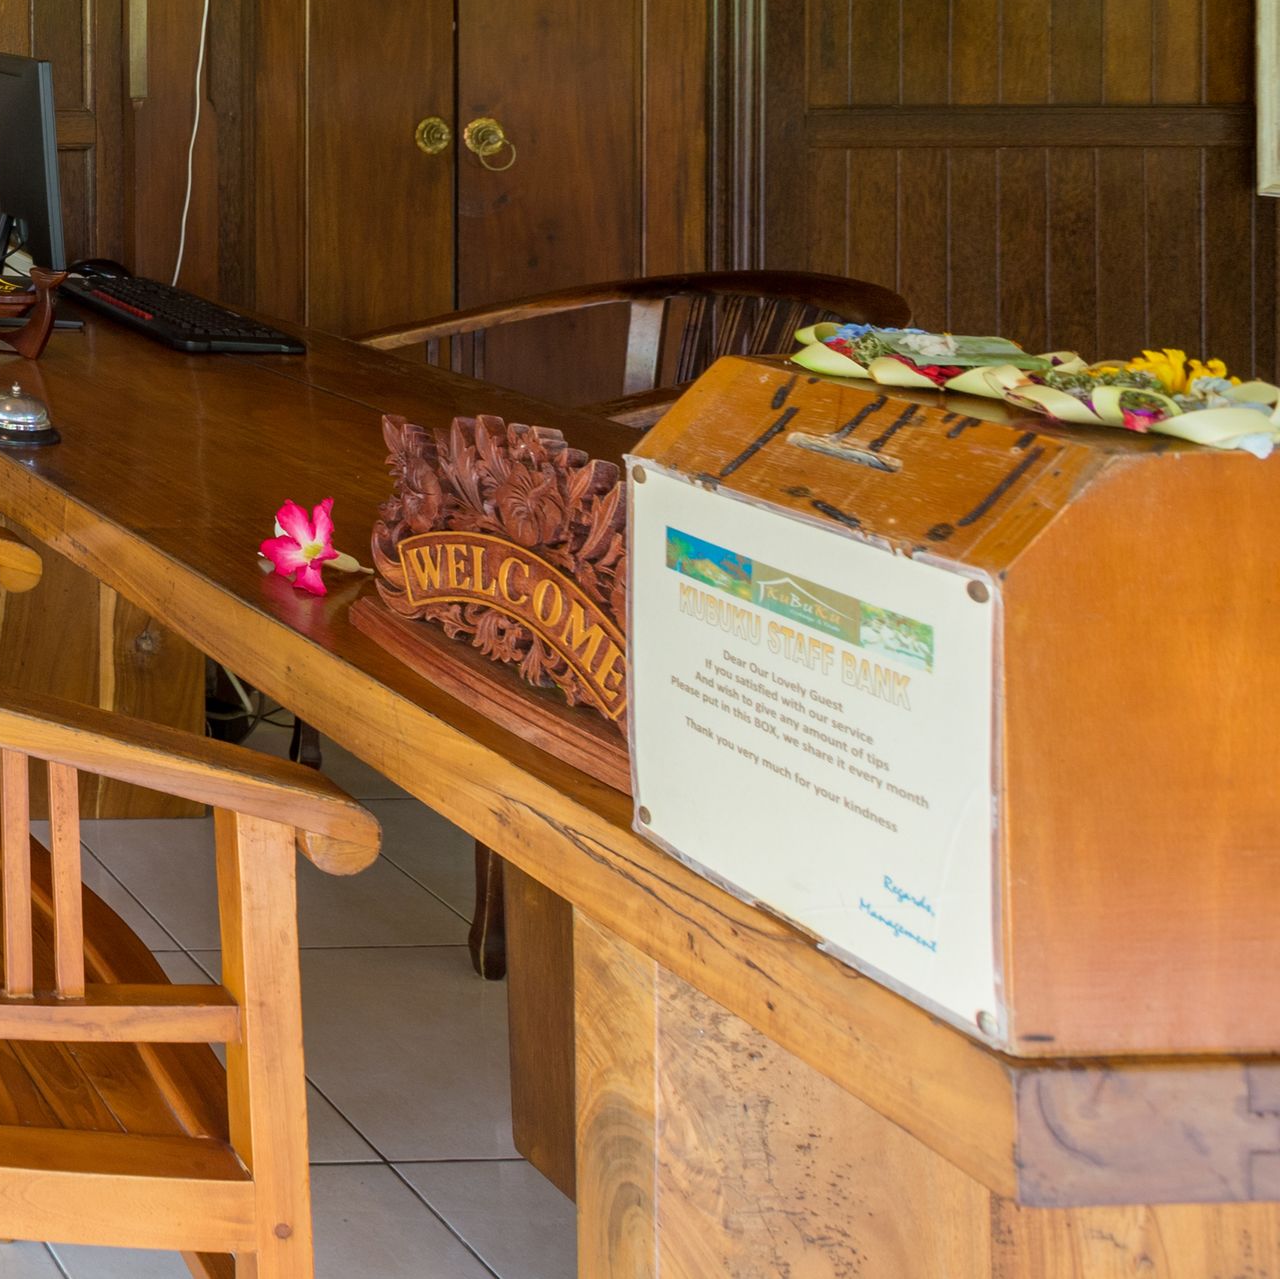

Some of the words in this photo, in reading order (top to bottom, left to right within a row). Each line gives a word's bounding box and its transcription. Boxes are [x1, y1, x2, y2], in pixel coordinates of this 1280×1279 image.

[406, 543, 627, 703] WELCOME
[678, 581, 762, 646] KUBUKU
[766, 619, 836, 677] STAFF
[840, 649, 912, 712] BANK
[694, 671, 715, 689] And
[716, 680, 740, 700] wish
[741, 694, 753, 706] to
[754, 699, 777, 720] give
[779, 713, 799, 732] any
[802, 722, 849, 753] amount
[851, 744, 865, 760] of
[866, 751, 890, 772] tips
[704, 658, 713, 670] If
[713, 665, 733, 681] you
[735, 672, 779, 702] satisfied
[781, 694, 807, 715] with
[808, 708, 829, 725] our
[831, 719, 875, 746] service
[722, 649, 747, 669] Dear
[749, 662, 769, 678] Our
[771, 671, 807, 698] Lovely
[809, 689, 844, 714] Guest
[670, 674, 701, 700] Please
[702, 691, 719, 711] put
[720, 699, 731, 713] in
[732, 705, 751, 725] this
[753, 716, 780, 741] BOX,
[782, 731, 800, 748] we
[802, 738, 834, 765] share
[836, 754, 846, 770] it
[848, 764, 883, 789] every
[885, 781, 930, 810] month
[684, 715, 715, 740] Thank
[715, 733, 735, 751] you
[736, 744, 760, 766] very
[761, 756, 792, 781] much
[793, 771, 811, 790] for
[813, 783, 841, 805] your
[842, 796, 899, 833] kindness
[859, 897, 937, 953] Management
